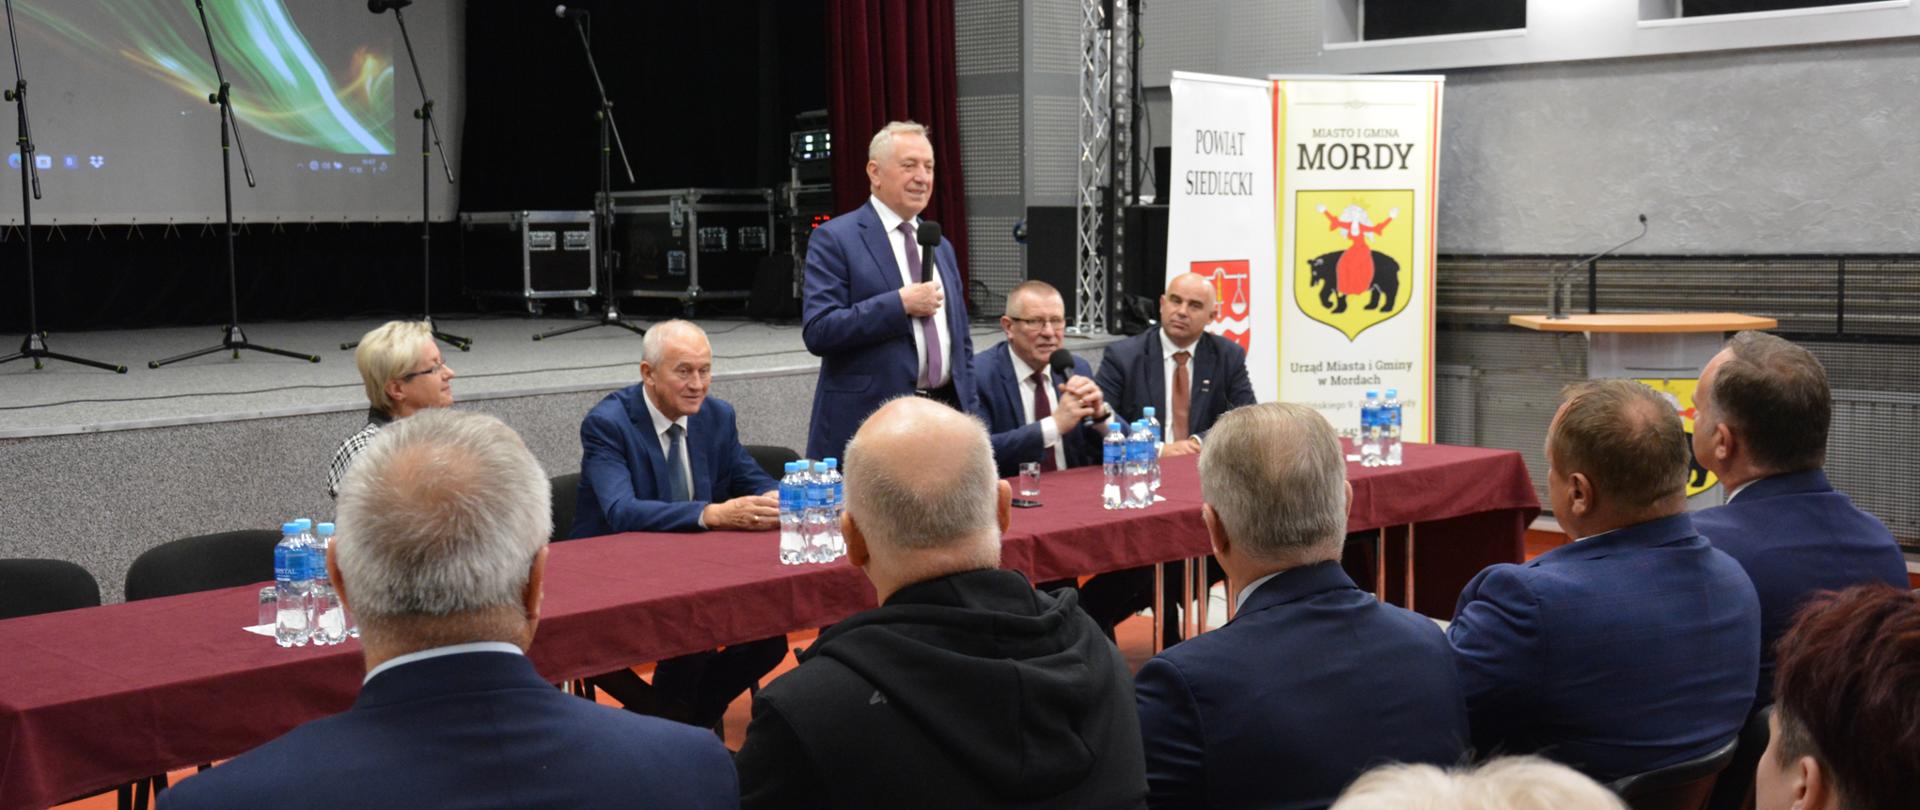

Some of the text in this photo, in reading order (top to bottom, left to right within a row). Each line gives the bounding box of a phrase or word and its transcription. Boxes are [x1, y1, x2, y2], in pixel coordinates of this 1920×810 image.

[1195, 130, 1245, 156] POWIAT
[1312, 128, 1355, 138] MIASTO
[1363, 128, 1400, 138] GMINA
[1296, 143, 1414, 170] MORDY
[1185, 170, 1253, 196] SIEDLECKI
[1290, 362, 1323, 374] Urząd
[1326, 361, 1366, 372] Miasta
[1375, 360, 1413, 373] Gminy
[1318, 374, 1381, 386] w Mordach
